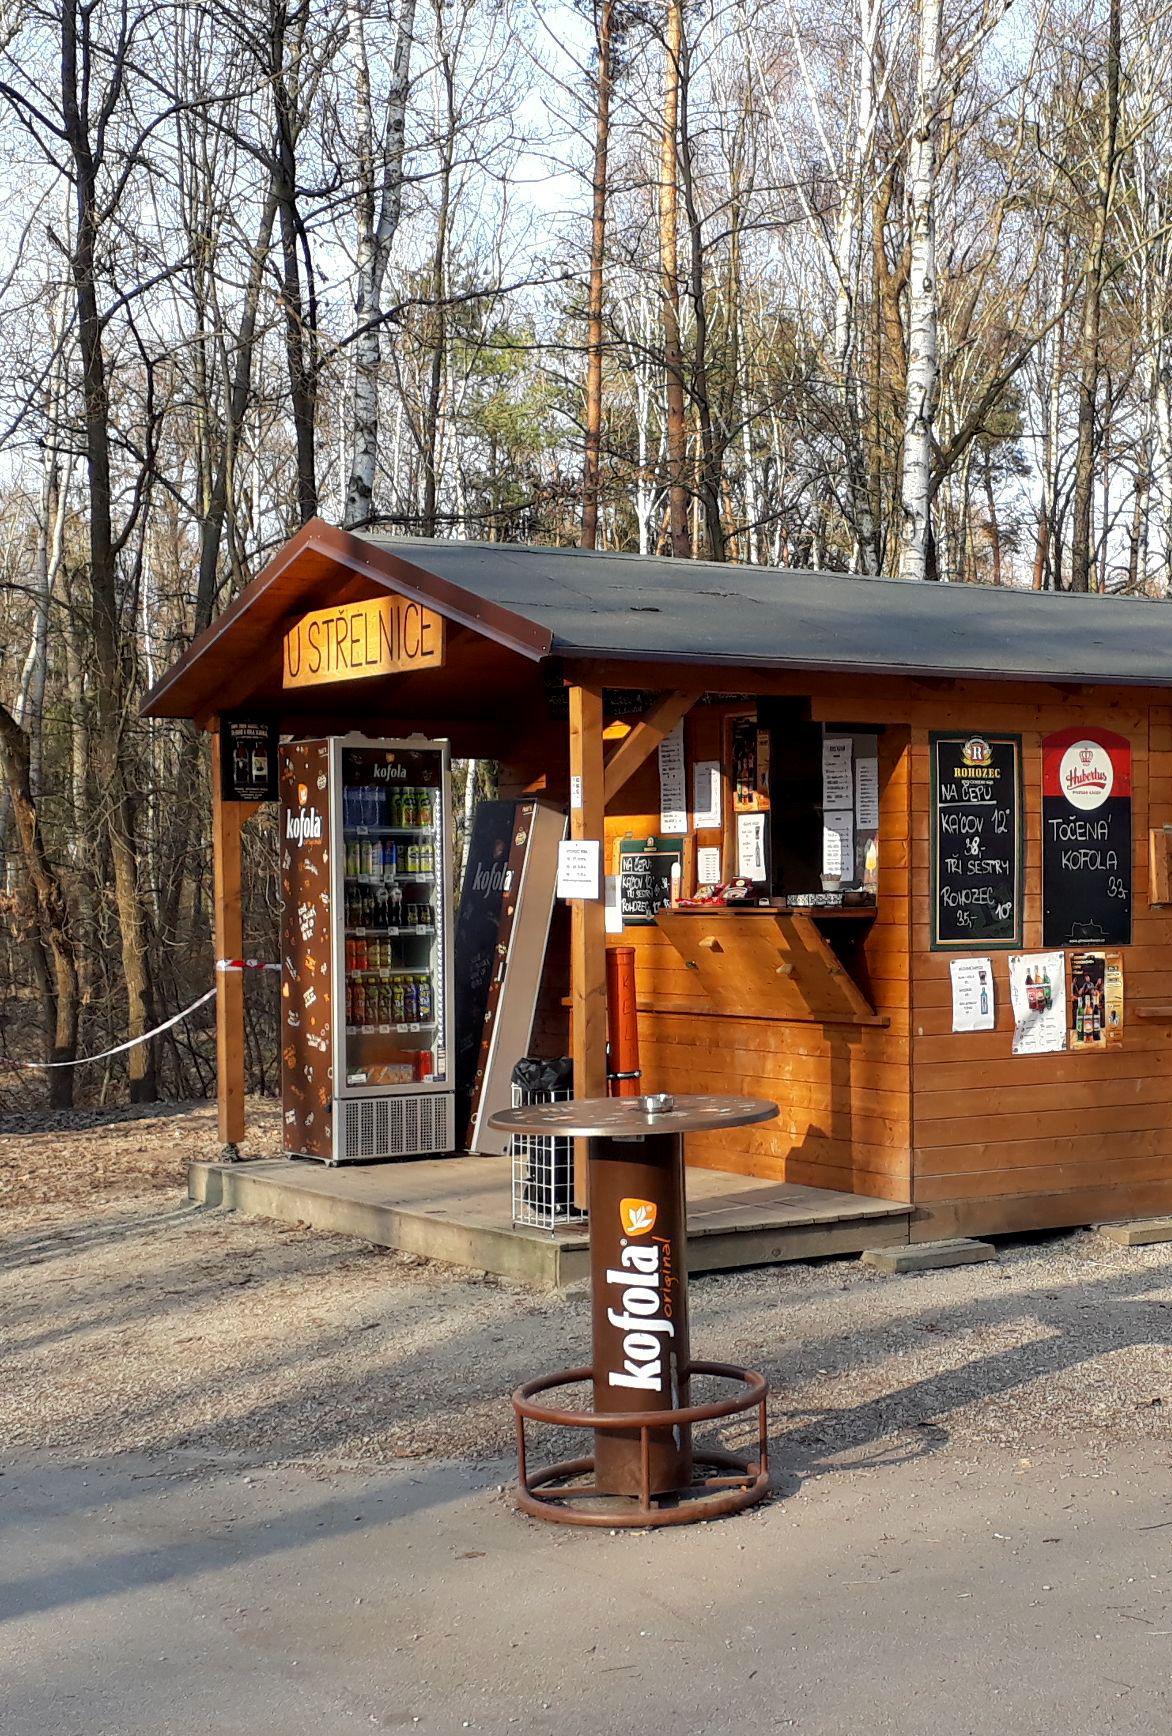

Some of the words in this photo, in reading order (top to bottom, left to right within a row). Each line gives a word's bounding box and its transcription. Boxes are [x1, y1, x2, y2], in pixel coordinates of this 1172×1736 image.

[287, 626, 301, 677] U
[308, 603, 434, 674] STŘELNICE
[373, 763, 407, 781] kofola
[953, 767, 1001, 779] ROHOZEC
[1065, 766, 1107, 788] Hubertus
[941, 784, 958, 800] NA
[961, 778, 992, 802] ČEPU
[286, 807, 321, 847] kofola
[1048, 814, 1112, 842] TOČENÁ
[967, 859, 1009, 876] SESTRY
[1061, 849, 1118, 871] KOFOLA
[941, 886, 995, 907] ROHOZEC
[606, 1243, 675, 1393] kofola
[652, 1236, 680, 1318] original
